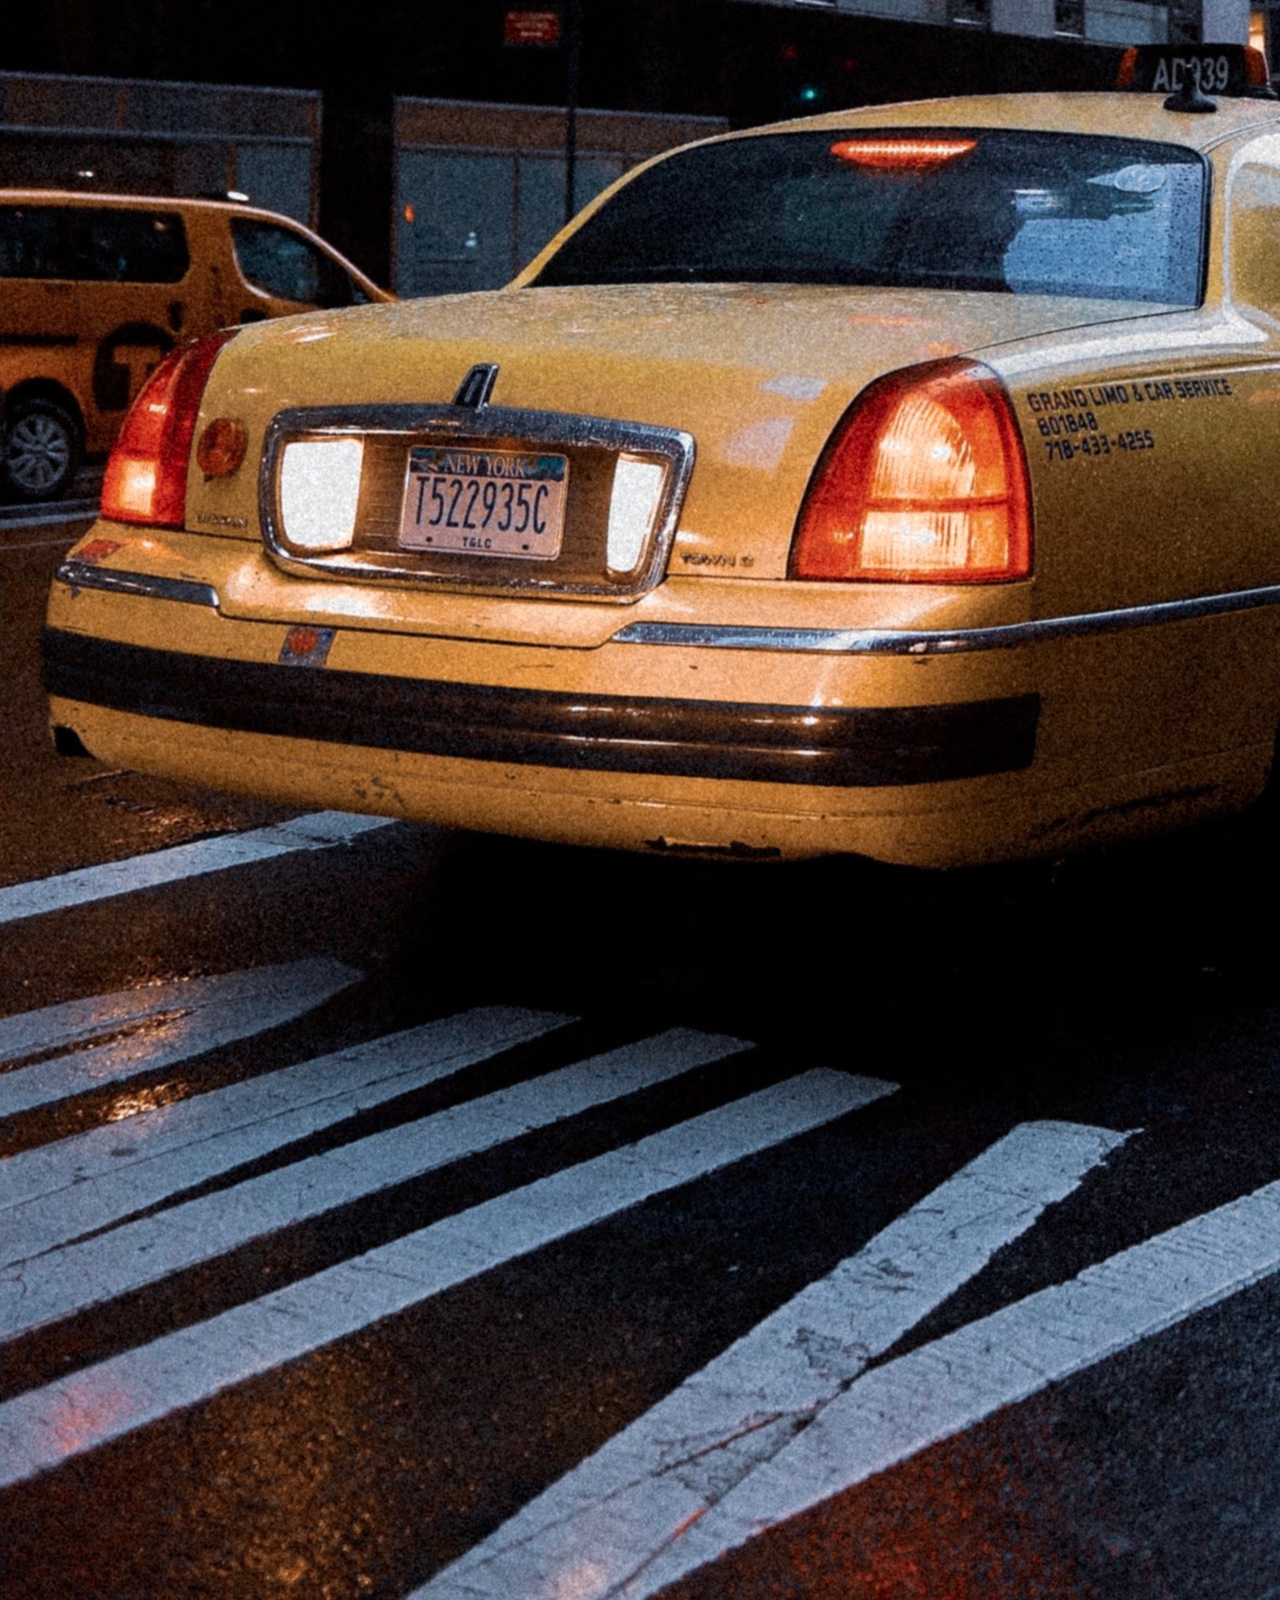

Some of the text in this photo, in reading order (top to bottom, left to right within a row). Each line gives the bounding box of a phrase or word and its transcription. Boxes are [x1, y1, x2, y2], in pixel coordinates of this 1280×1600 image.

[1027, 378, 1233, 412] GRAND LIMO & CAR SERVICE
[1045, 429, 1155, 461] 718-433-4255
[445, 454, 526, 478] NEW YORK
[416, 476, 549, 534] T522935C
